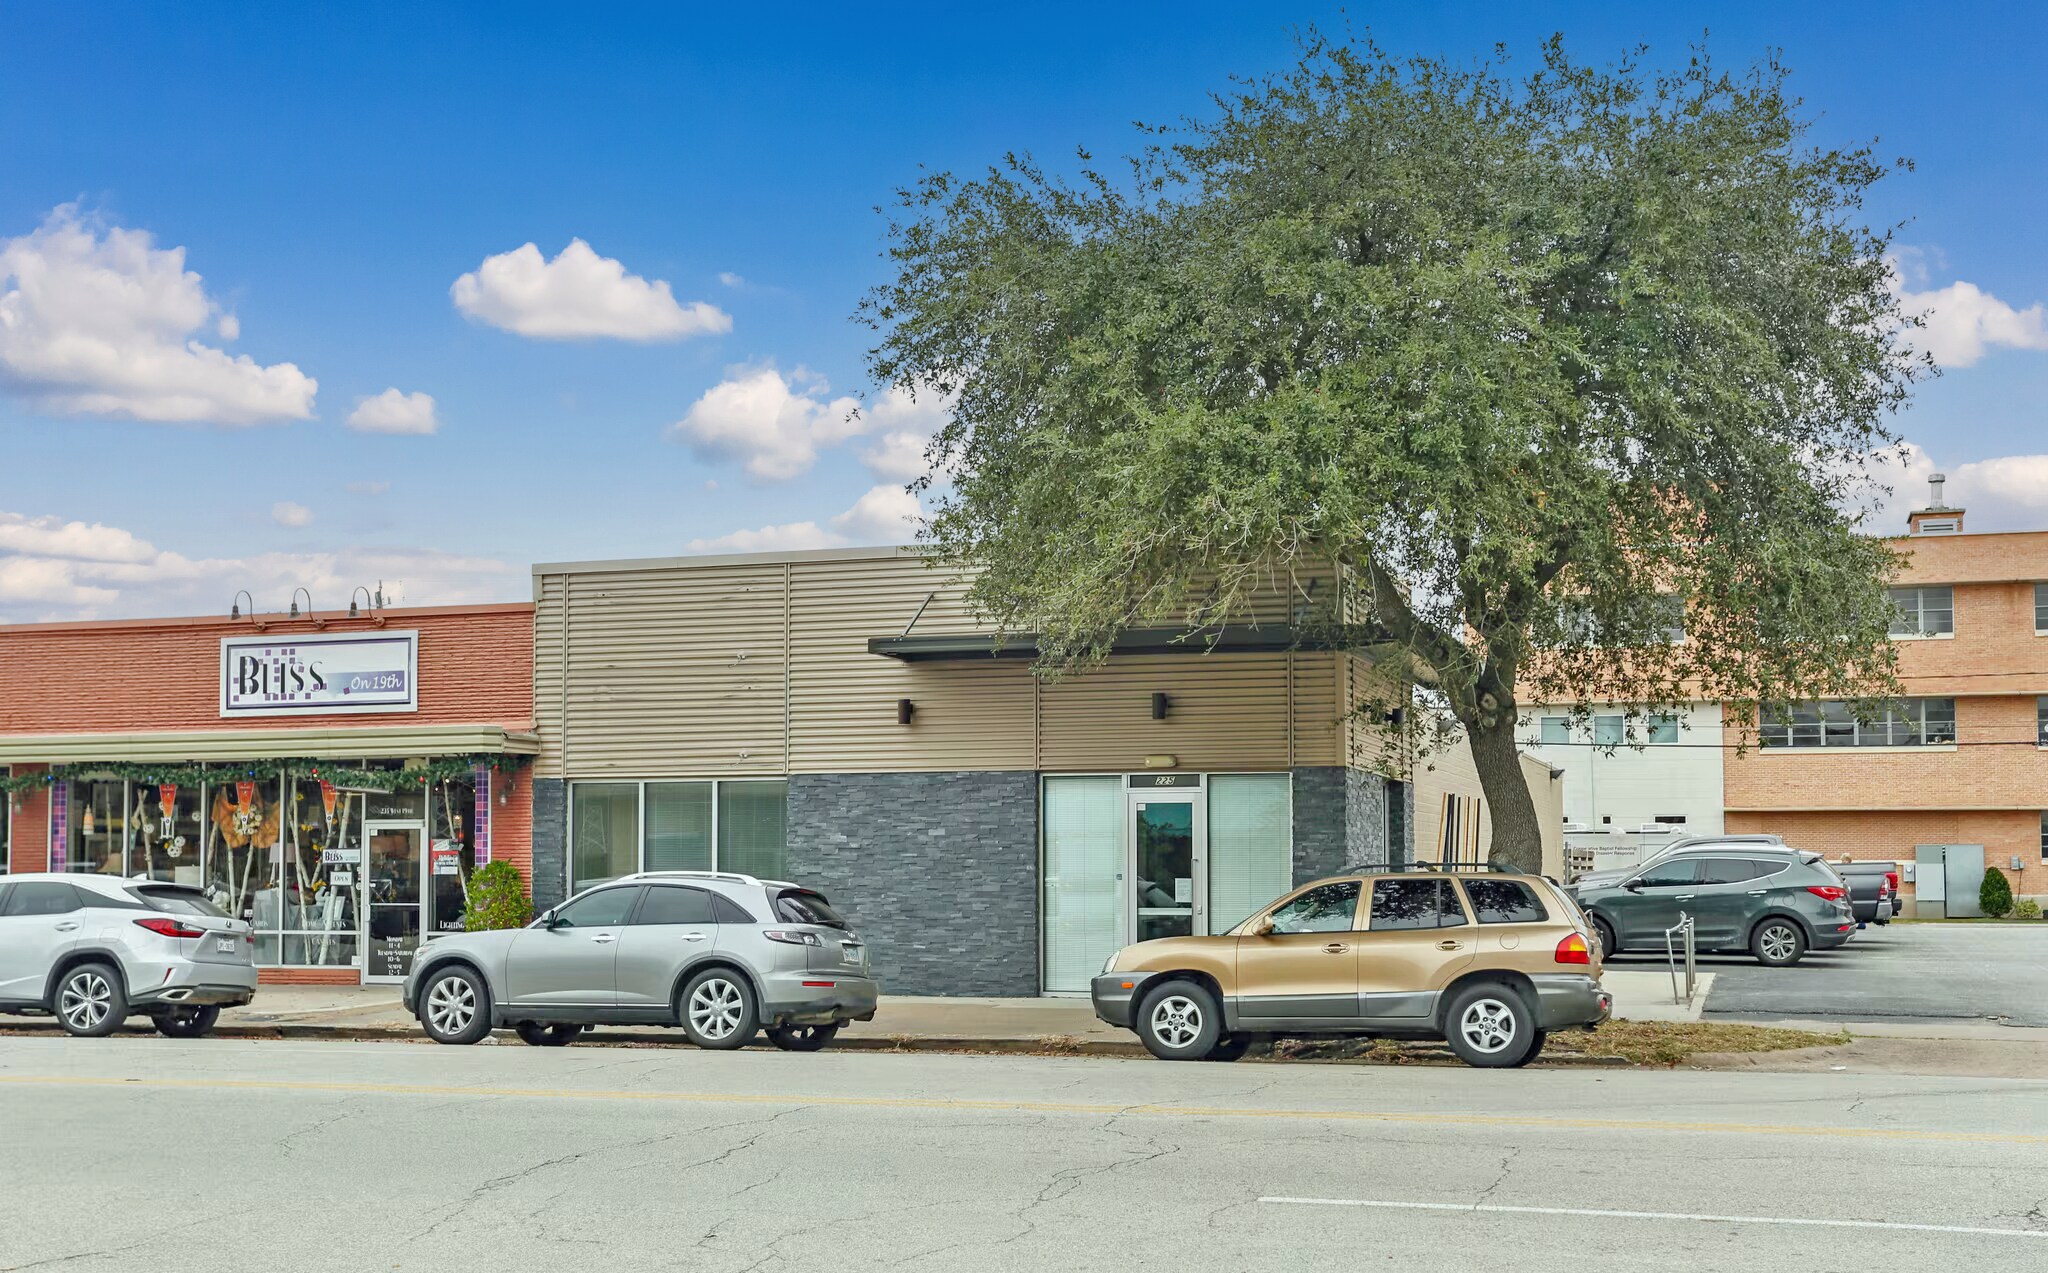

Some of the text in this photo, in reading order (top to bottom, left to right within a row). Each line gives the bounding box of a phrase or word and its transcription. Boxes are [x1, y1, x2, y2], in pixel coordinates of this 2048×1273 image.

[239, 655, 403, 695] BLISS On 19th
[1156, 776, 1174, 785] 225
